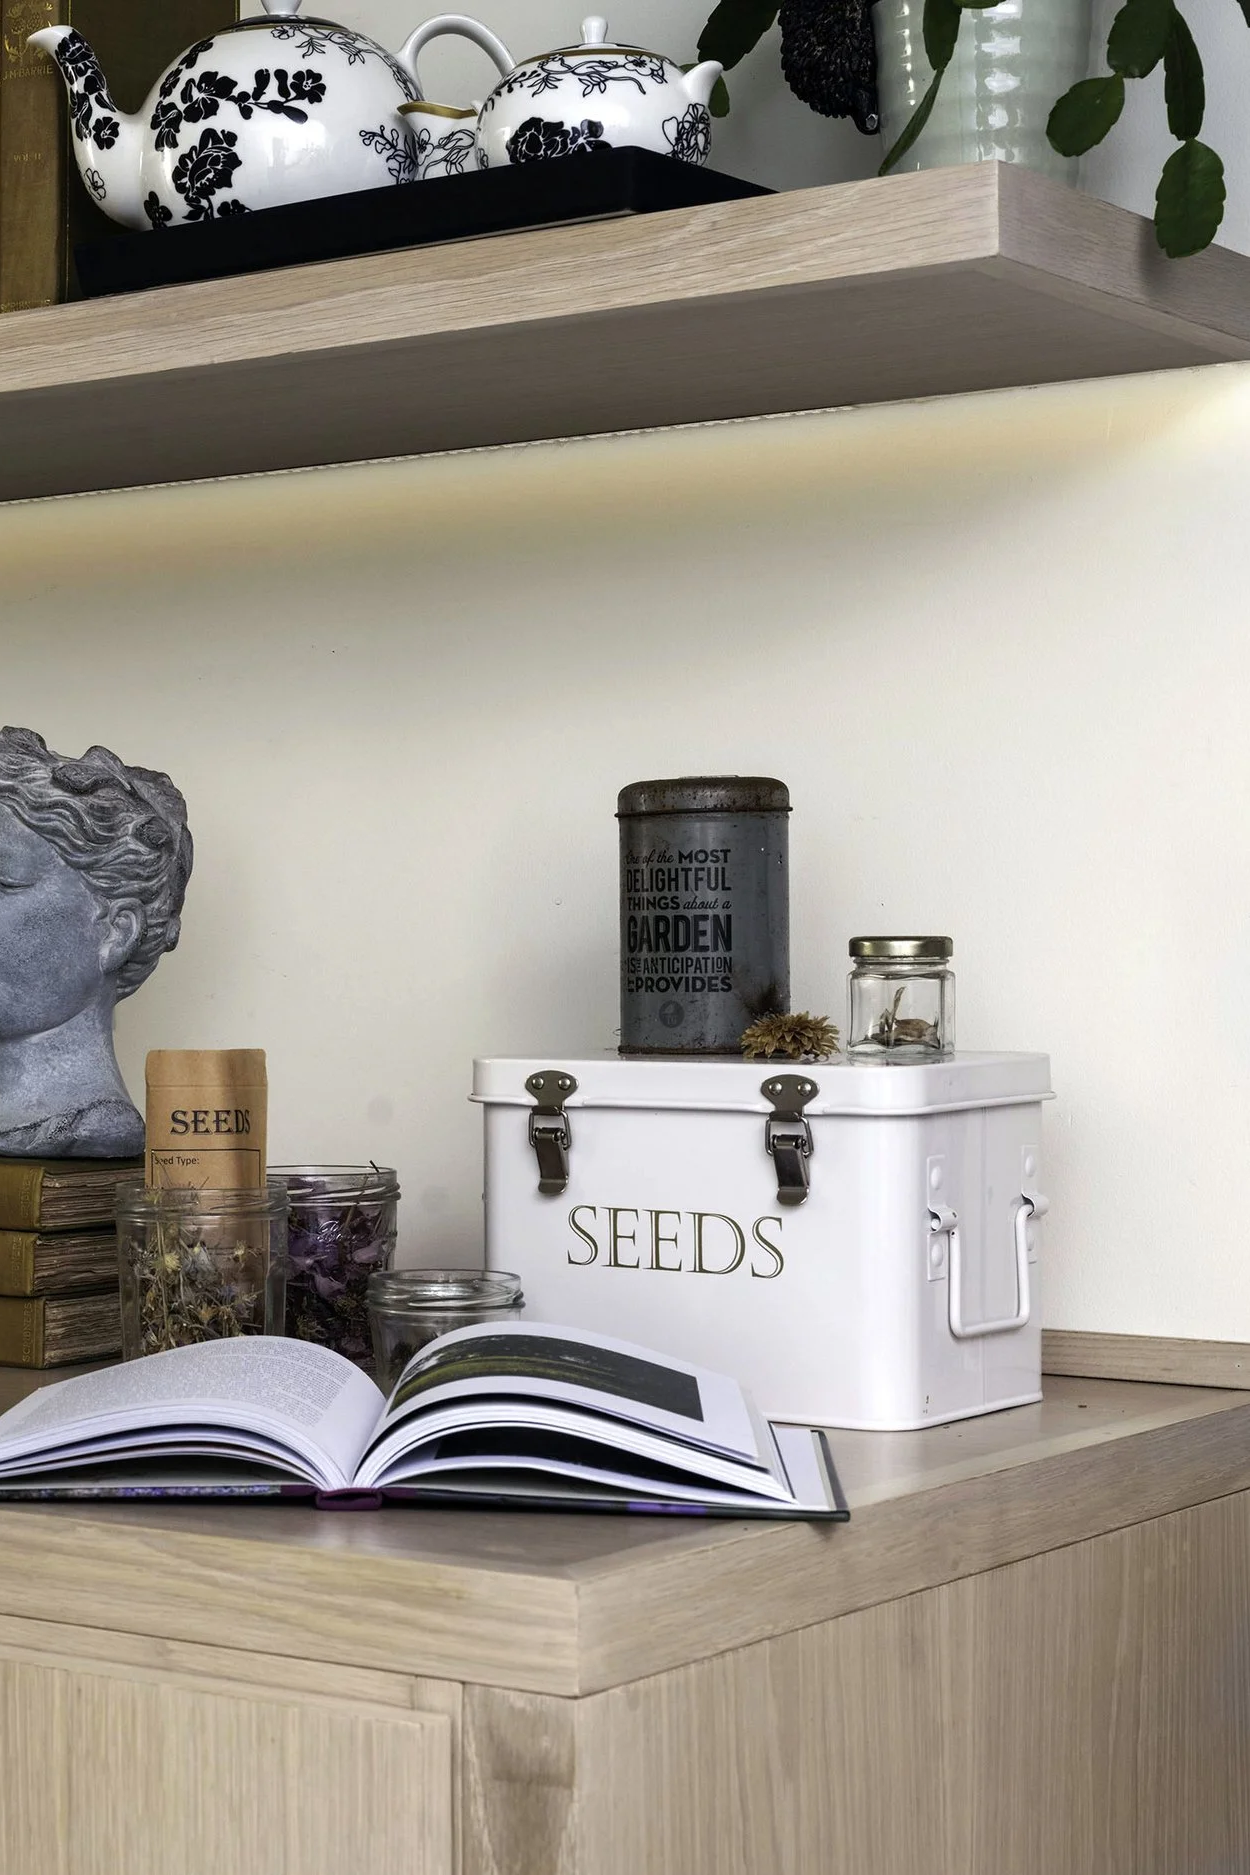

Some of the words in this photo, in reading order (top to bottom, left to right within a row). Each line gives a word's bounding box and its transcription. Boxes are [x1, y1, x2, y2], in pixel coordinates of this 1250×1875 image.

[642, 849, 655, 868] of
[656, 850, 674, 864] the
[678, 849, 731, 864] MOST
[626, 867, 732, 893] DELIGHTFUL
[628, 896, 680, 911] THINGS
[683, 895, 718, 910] about
[722, 900, 732, 910] a
[627, 914, 732, 953] GARDEN
[643, 957, 732, 975] ANTICIPATION
[635, 976, 733, 993] PROVIDES
[171, 1109, 251, 1135] SEEDS
[176, 1155, 200, 1167] Type:
[567, 1204, 785, 1279] SEEDS
[22, 1302, 32, 1363] SCRIBNERS
